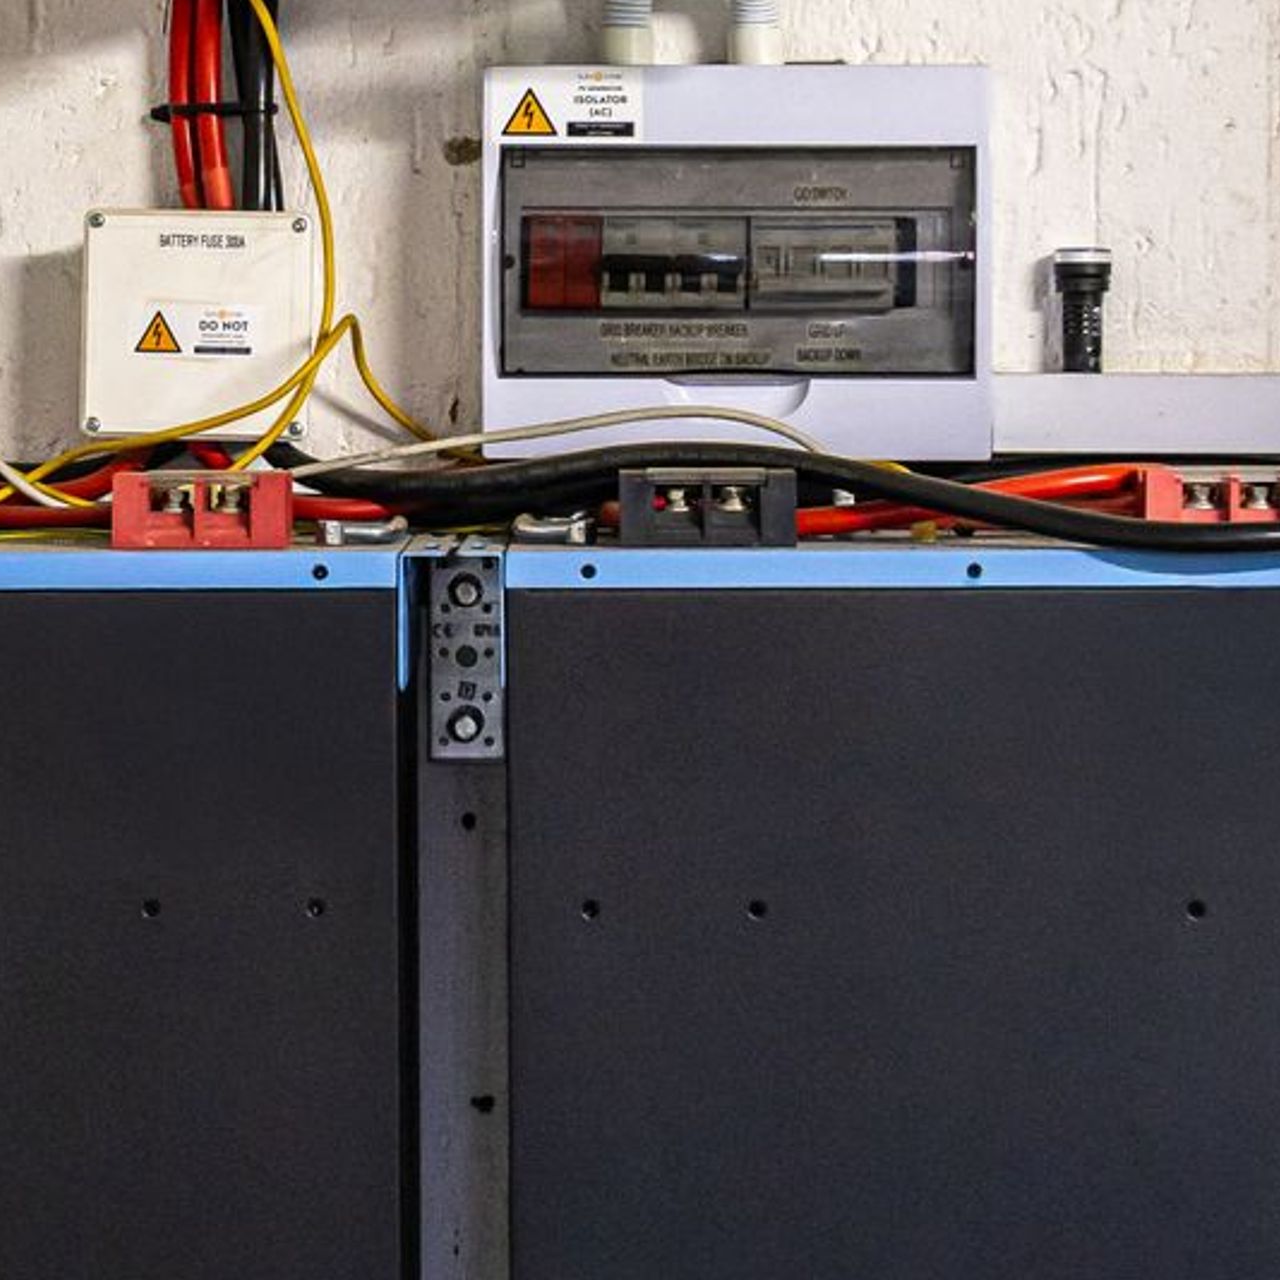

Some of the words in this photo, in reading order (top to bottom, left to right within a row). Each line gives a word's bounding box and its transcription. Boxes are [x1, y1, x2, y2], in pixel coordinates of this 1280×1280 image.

[573, 95, 627, 104] ISOLATOR
[160, 234, 197, 247] BATTERY
[201, 234, 223, 248] FUSE
[199, 321, 218, 331] DO
[222, 321, 248, 331] NOT
